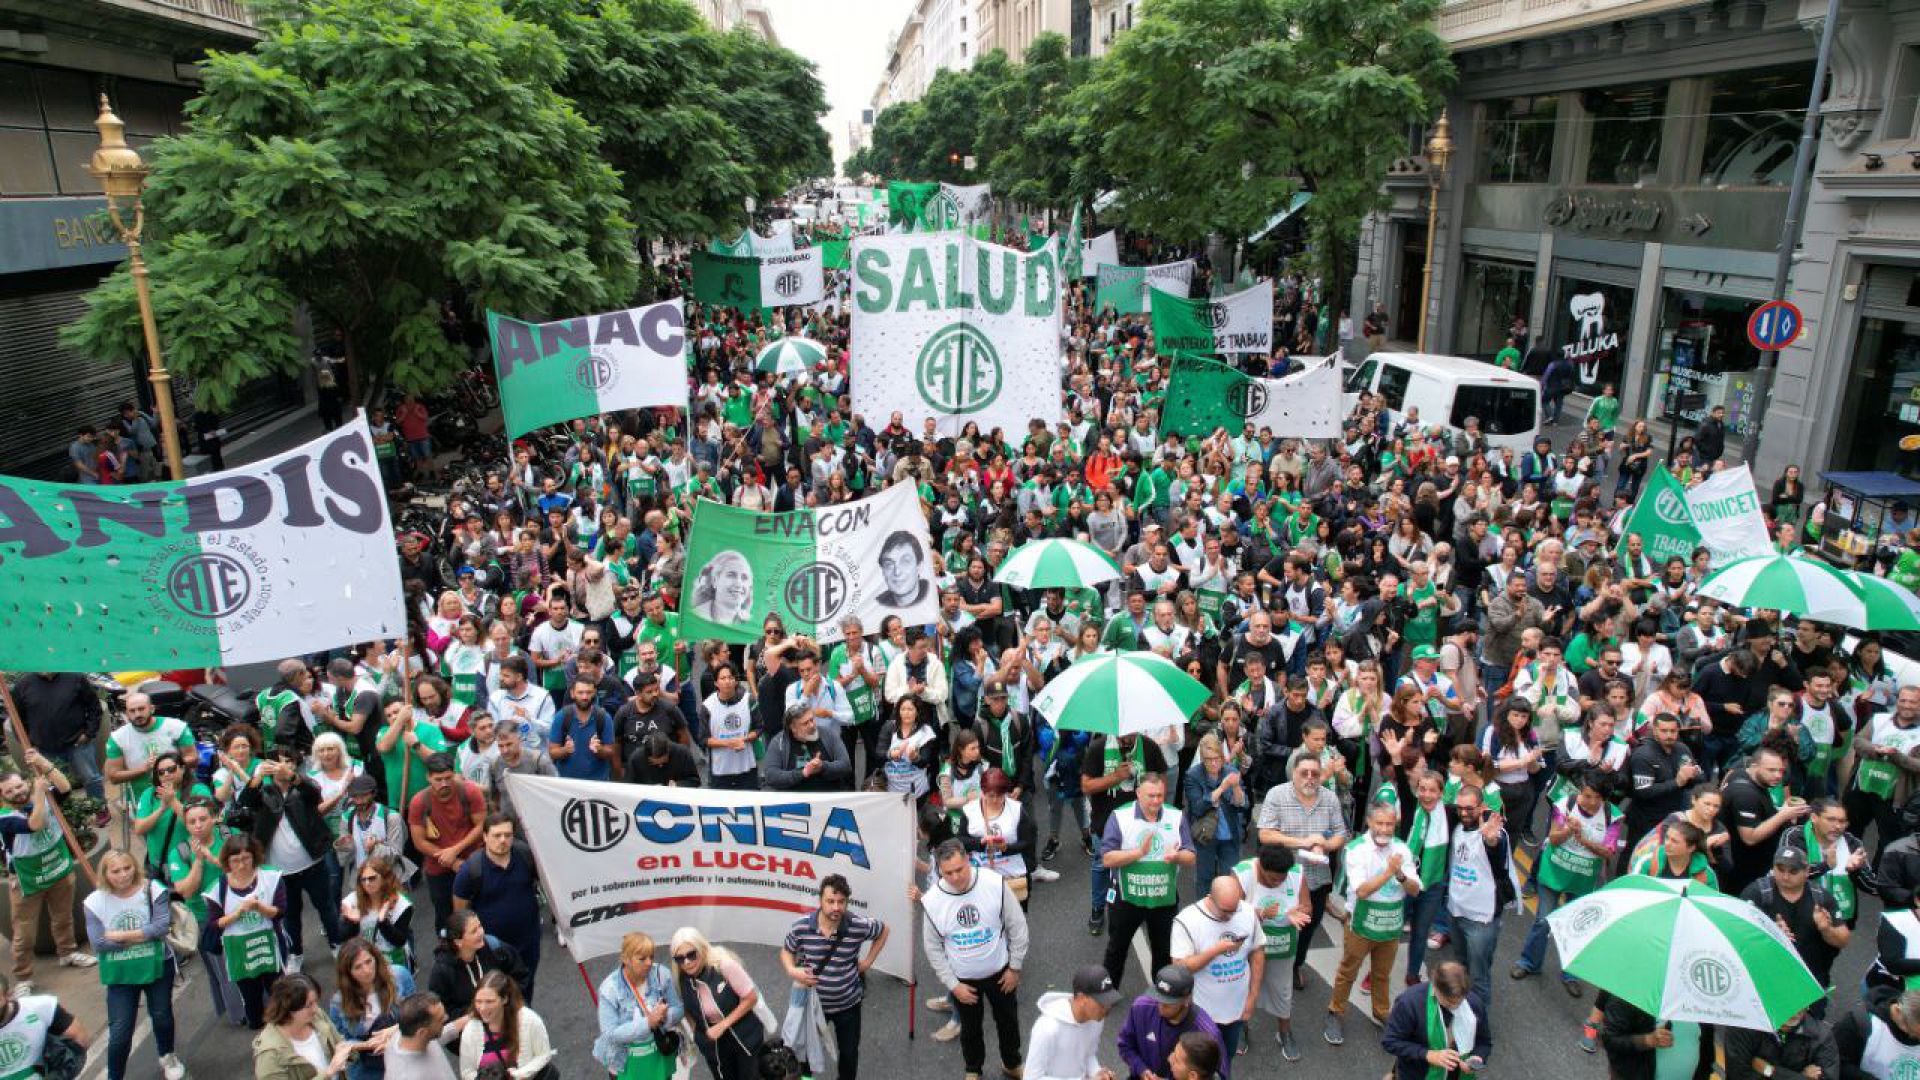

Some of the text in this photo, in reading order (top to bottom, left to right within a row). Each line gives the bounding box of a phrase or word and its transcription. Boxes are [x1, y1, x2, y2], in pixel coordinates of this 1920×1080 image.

[778, 273, 799, 294] ATE
[856, 244, 1056, 316] SALUD
[496, 304, 684, 378] ANAC
[1214, 336, 1225, 348] DE
[1229, 333, 1267, 348] TRABAJO
[1562, 332, 1618, 359] TULUKA
[577, 358, 606, 387] ATE
[927, 333, 991, 408] ATE
[1232, 386, 1261, 411] ATE
[0, 431, 383, 563] ANDIS
[1692, 491, 1756, 521] CONICET
[754, 503, 871, 538] ENACOM
[173, 558, 242, 613] ATE
[791, 566, 838, 619] ATE
[567, 799, 871, 870] ATE CNEA
[637, 851, 817, 880] en LUCHA
[571, 888, 587, 901] por
[590, 885, 600, 894] la
[653, 874, 704, 885] energética
[714, 874, 724, 883] la
[1128, 885, 1136, 895] DE
[1138, 886, 1146, 896] LA
[958, 907, 979, 926] ATE
[1694, 961, 1726, 992] ATE
